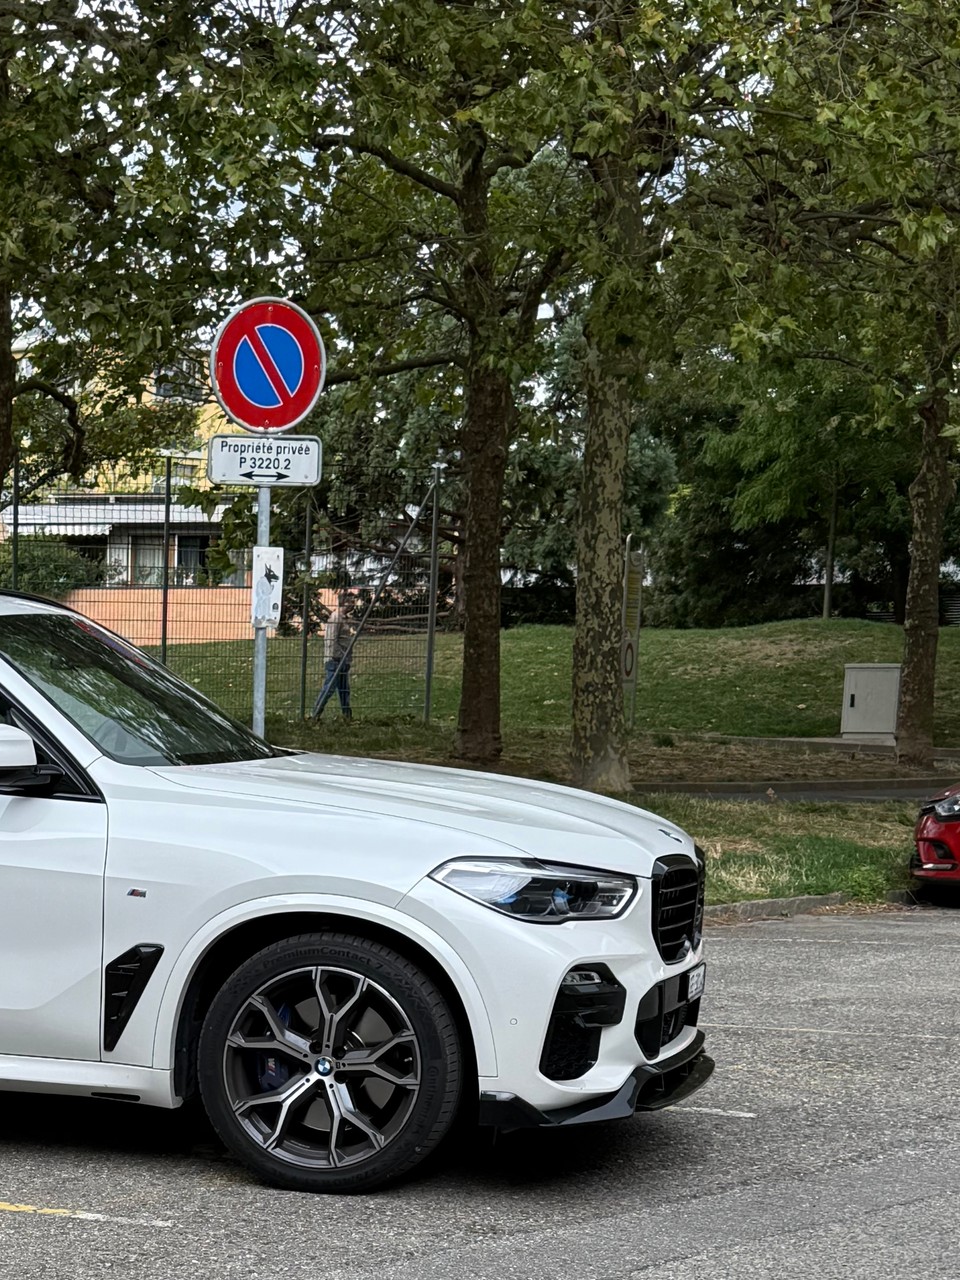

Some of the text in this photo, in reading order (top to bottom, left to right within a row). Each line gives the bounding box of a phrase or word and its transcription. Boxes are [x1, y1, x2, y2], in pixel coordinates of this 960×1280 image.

[220, 440, 311, 457] Propriété privée
[239, 457, 291, 470] P 3220.2
[262, 946, 384, 970] PremiumContact 7
